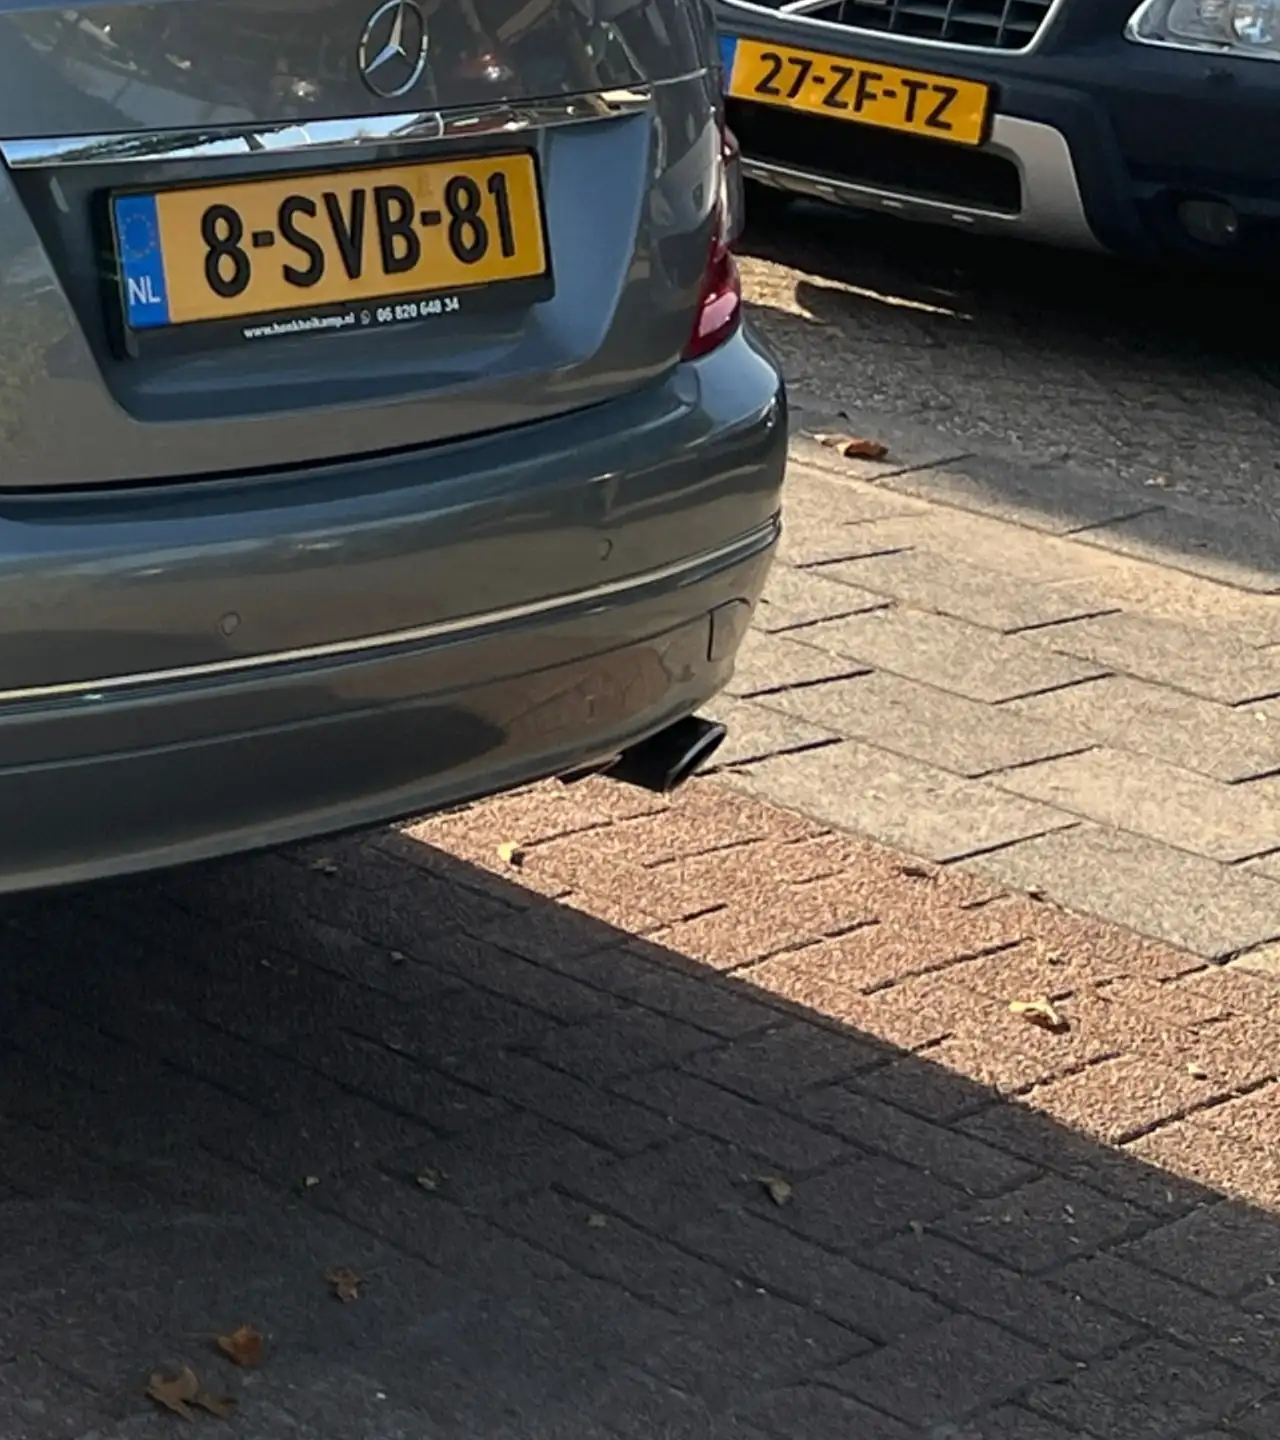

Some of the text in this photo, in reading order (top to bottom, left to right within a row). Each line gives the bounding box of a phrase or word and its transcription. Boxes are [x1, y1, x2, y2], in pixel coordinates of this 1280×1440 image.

[754, 52, 958, 131] 27-ZF-TZ
[201, 172, 516, 298] 8-SVB-81
[128, 275, 162, 306] NL
[376, 306, 393, 323] 06
[396, 303, 418, 321] 820
[444, 295, 460, 312] 34
